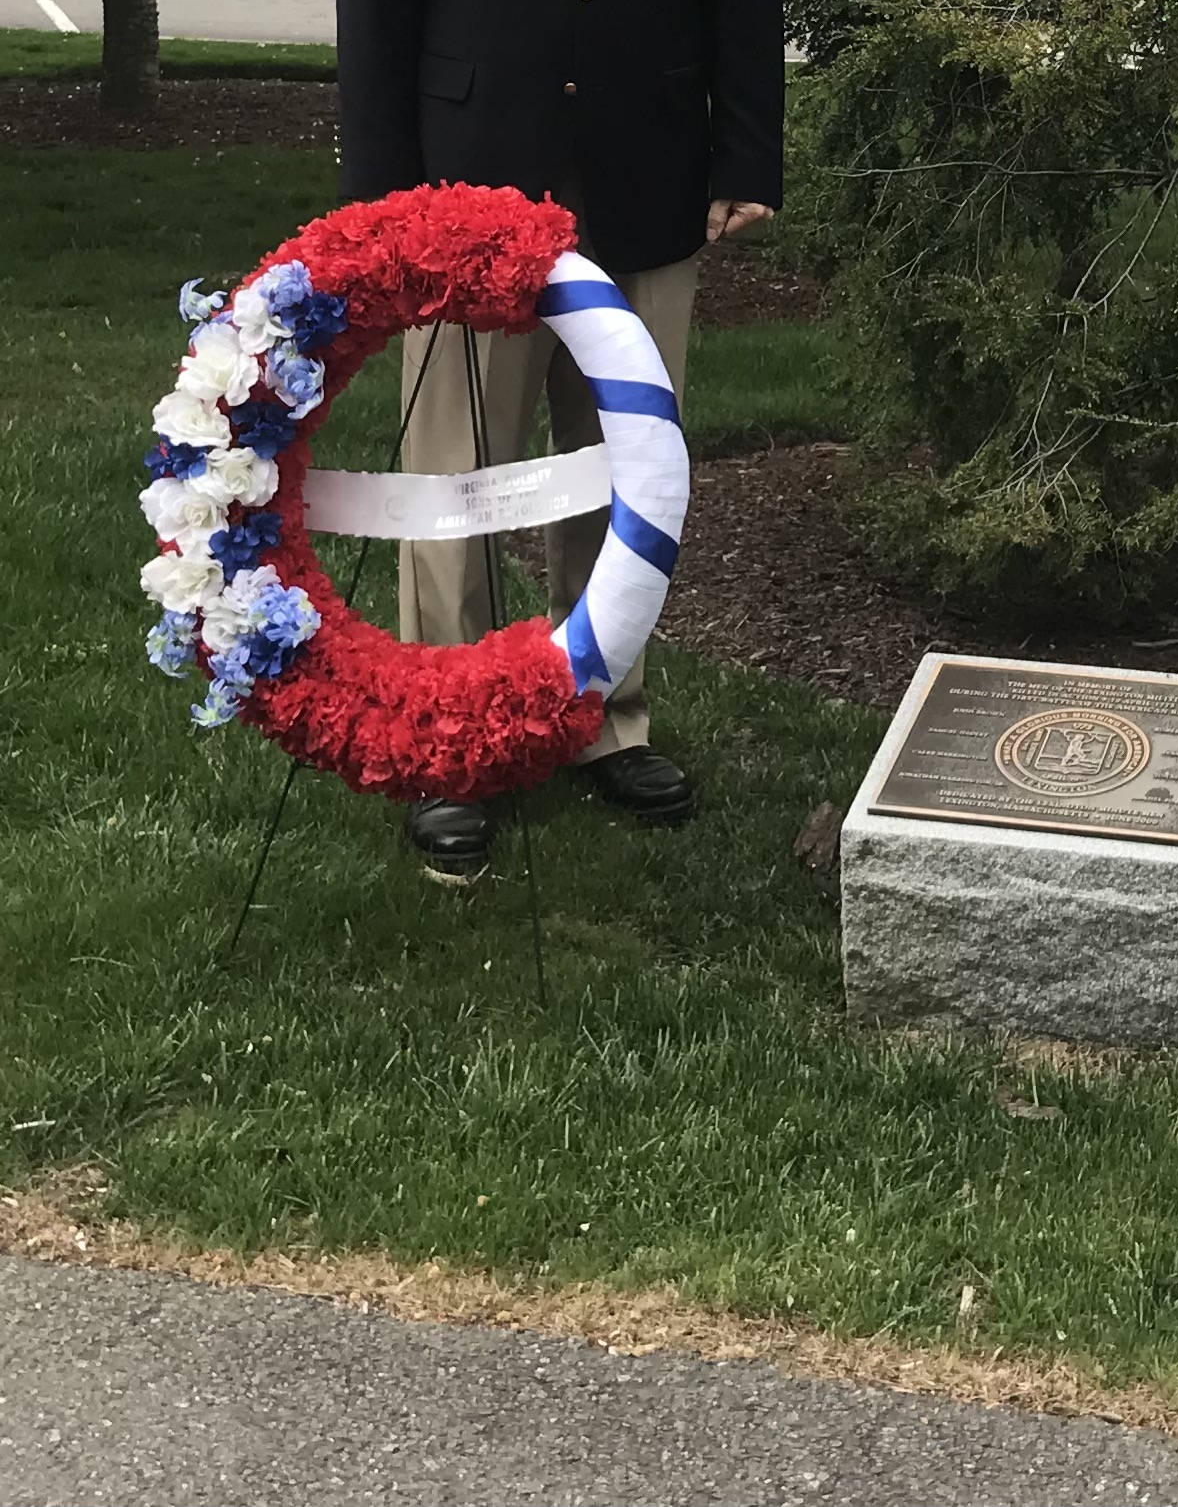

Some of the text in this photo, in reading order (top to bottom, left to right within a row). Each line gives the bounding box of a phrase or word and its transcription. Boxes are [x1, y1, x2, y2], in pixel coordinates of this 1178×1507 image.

[455, 468, 552, 495] VIRGINIA SOCIETY
[466, 496, 492, 510] SONS
[497, 494, 512, 506] OF
[498, 494, 569, 521] REVOLION
[1011, 688, 1046, 696] KILLED
[1060, 693, 1100, 701] ACTION
[1078, 681, 1117, 690] MEMORY
[1088, 689, 1144, 699] LEXINGTON
[949, 688, 988, 697] DURING
[1011, 694, 1038, 702] FIRST
[1040, 697, 1077, 705] BATTLE
[1115, 704, 1168, 714] AMERICAN
[1015, 712, 1068, 734] GLORIOUS
[1072, 712, 1122, 727] MORNING
[1121, 725, 1138, 740] FOR
[1021, 776, 1097, 793] LEXINGTON
[939, 789, 996, 801] DEDICATED
[1036, 799, 1097, 812] LEXINGTON
[1098, 806, 1140, 816] MINUTE
[1141, 810, 1165, 818] MEN
[939, 796, 1159, 825] LEXINGTON, MASSACHUSETTS JUNE 2000
